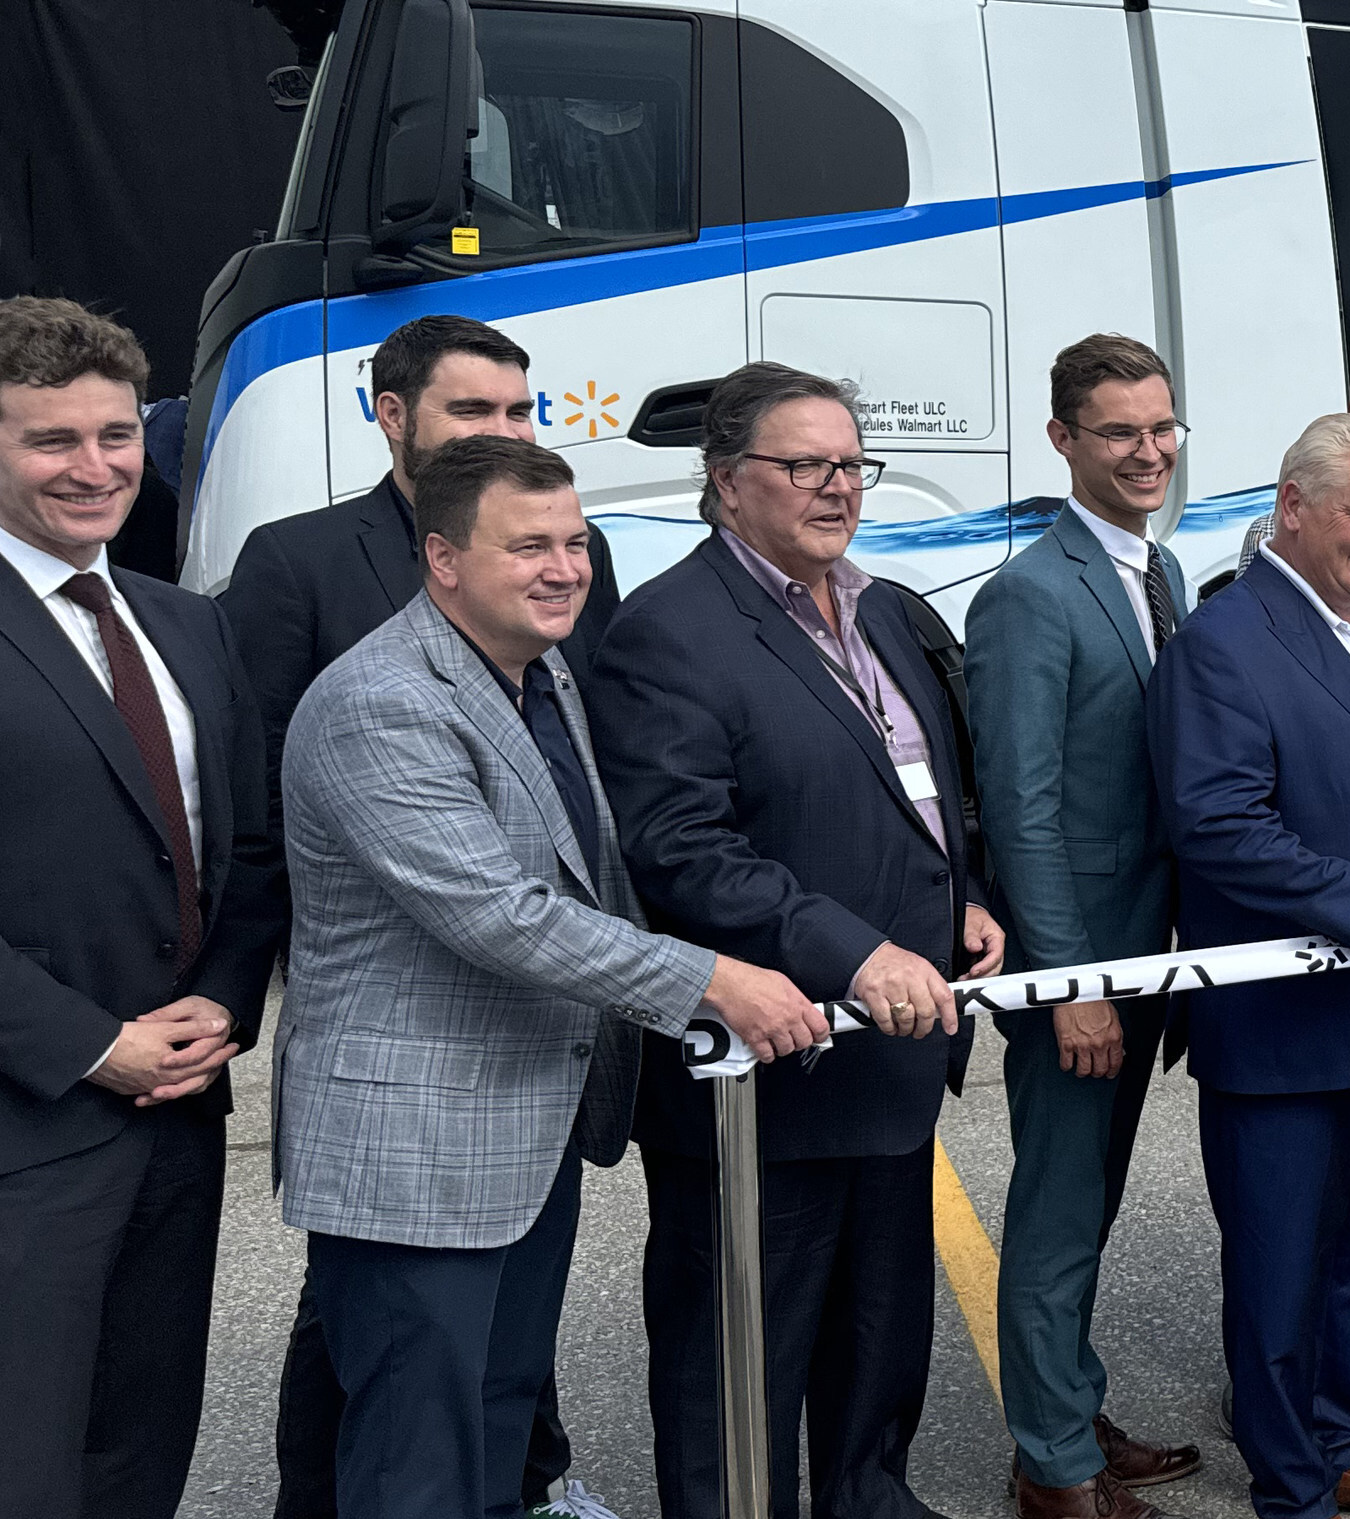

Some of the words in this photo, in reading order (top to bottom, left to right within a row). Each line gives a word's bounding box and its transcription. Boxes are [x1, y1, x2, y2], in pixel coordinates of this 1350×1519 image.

[891, 401, 919, 415] Fleet
[923, 401, 946, 416] ULC
[898, 418, 942, 432] Walmart
[947, 420, 968, 433] LLC
[824, 965, 1215, 1031] NKOLA
